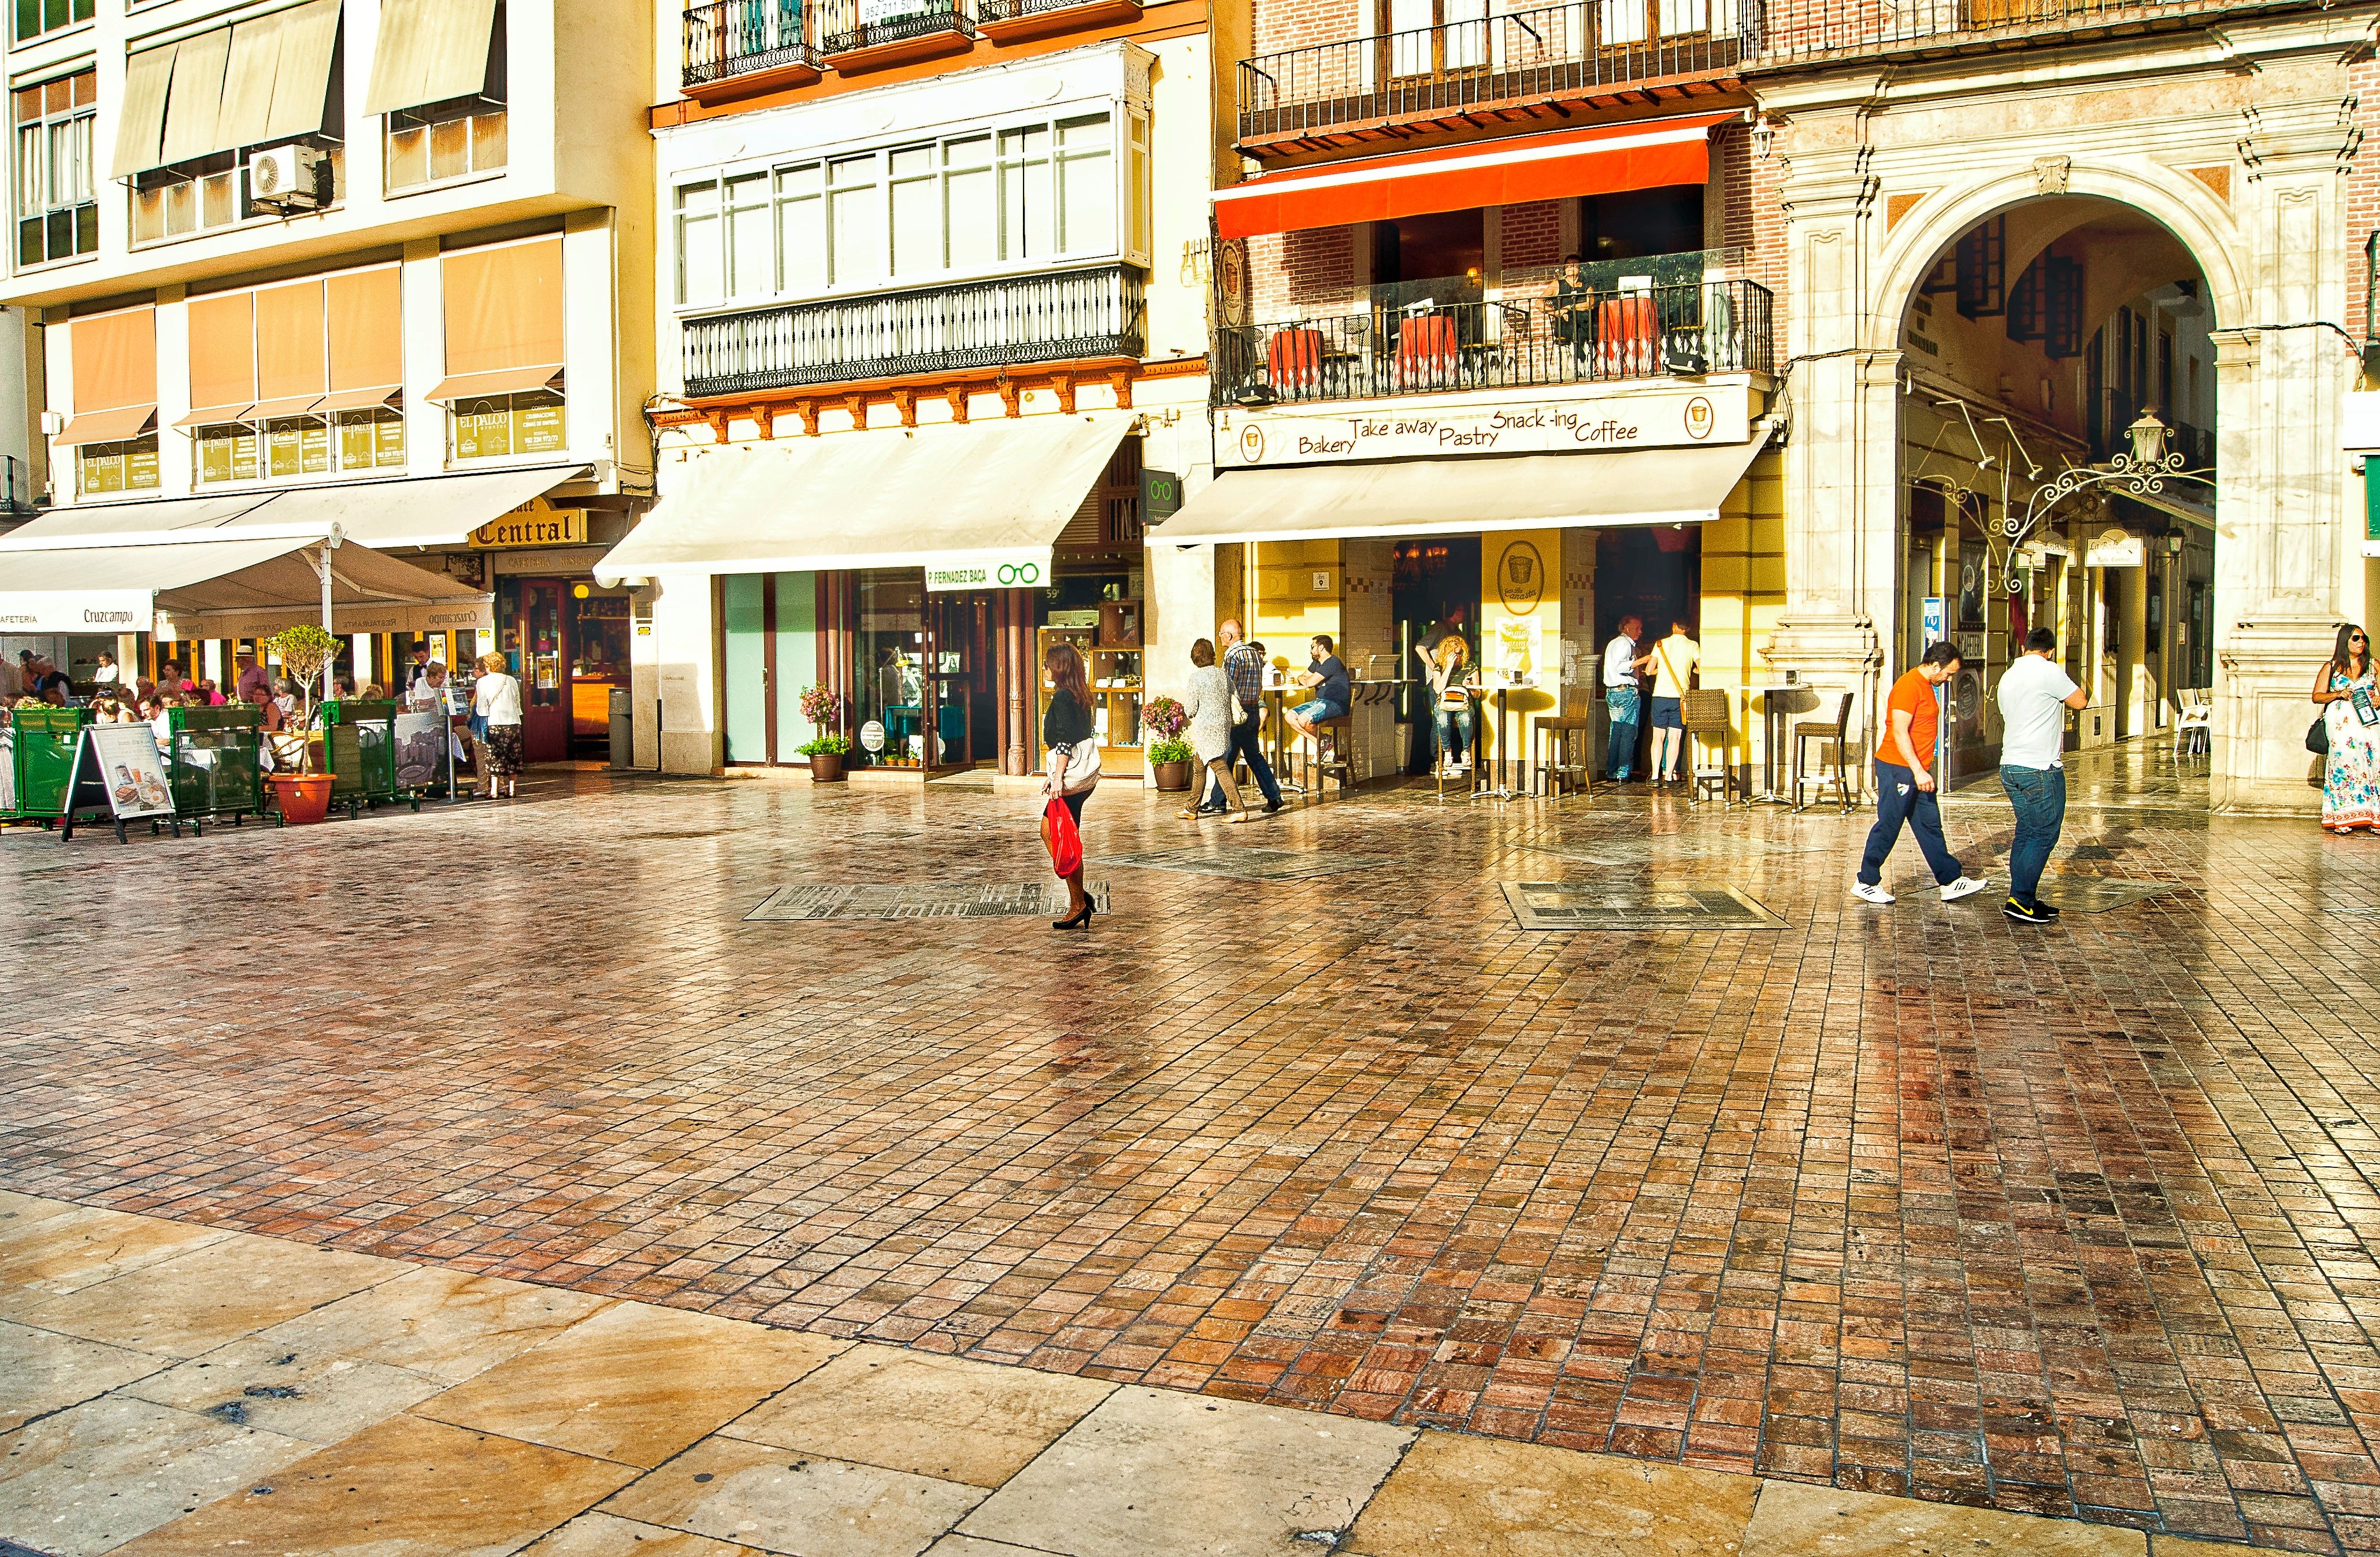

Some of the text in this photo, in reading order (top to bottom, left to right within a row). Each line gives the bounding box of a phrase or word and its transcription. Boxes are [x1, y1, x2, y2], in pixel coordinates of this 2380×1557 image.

[865, 0, 916, 18] 952 211 501
[459, 413, 507, 438] EL PALCO
[1299, 436, 1356, 454] Bakery
[1348, 418, 1388, 439] Take
[1395, 420, 1437, 436] away
[1440, 426, 1499, 447] Pastry
[1491, 408, 1545, 429] Snack
[1575, 420, 1637, 443] Coffee
[475, 515, 572, 545] Central
[2089, 542, 2099, 550] La
[0, 609, 133, 624] AFETERÍA Cruzcampo
